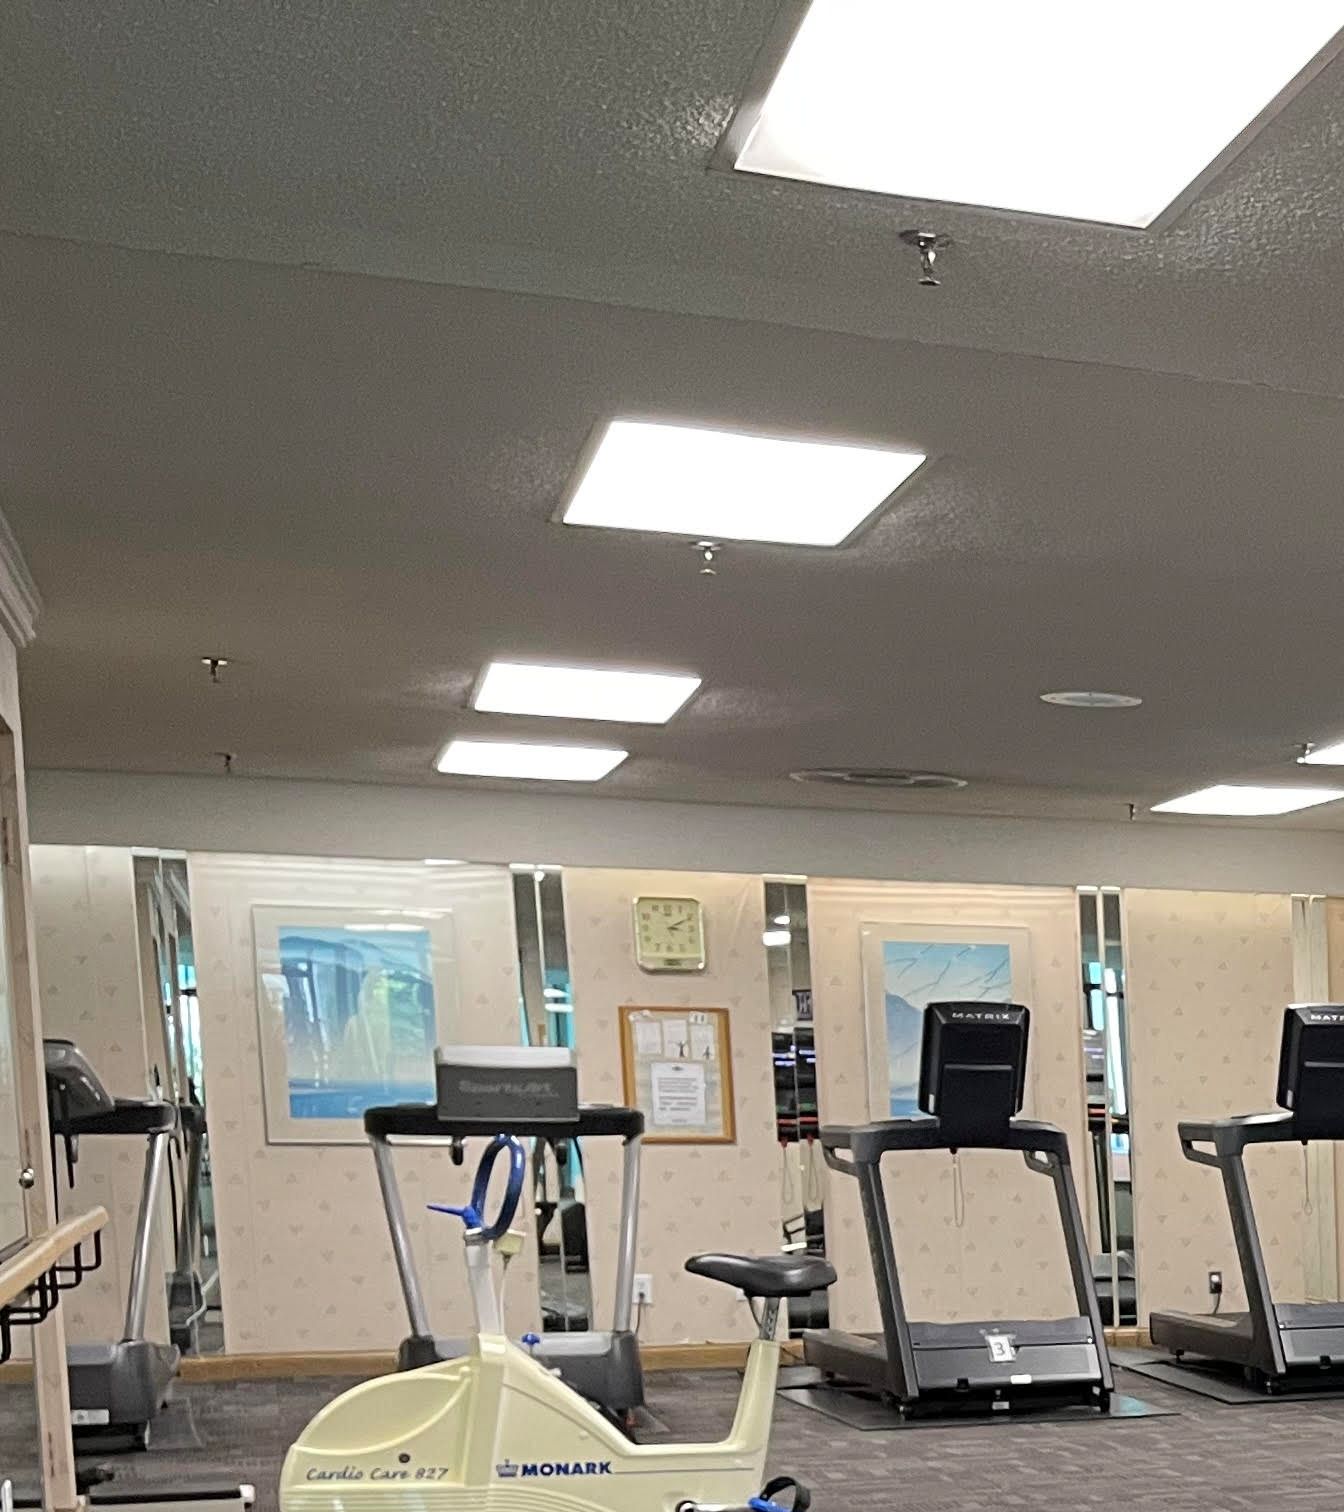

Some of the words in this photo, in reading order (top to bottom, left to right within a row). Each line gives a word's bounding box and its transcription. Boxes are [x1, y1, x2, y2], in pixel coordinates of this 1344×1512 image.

[952, 1012, 1009, 1020] MATRIX
[993, 1342, 1006, 1357] 3
[306, 1465, 363, 1480] Cardio
[370, 1467, 409, 1480] Care
[415, 1467, 448, 1480] 827
[521, 1461, 612, 1476] MONARK
